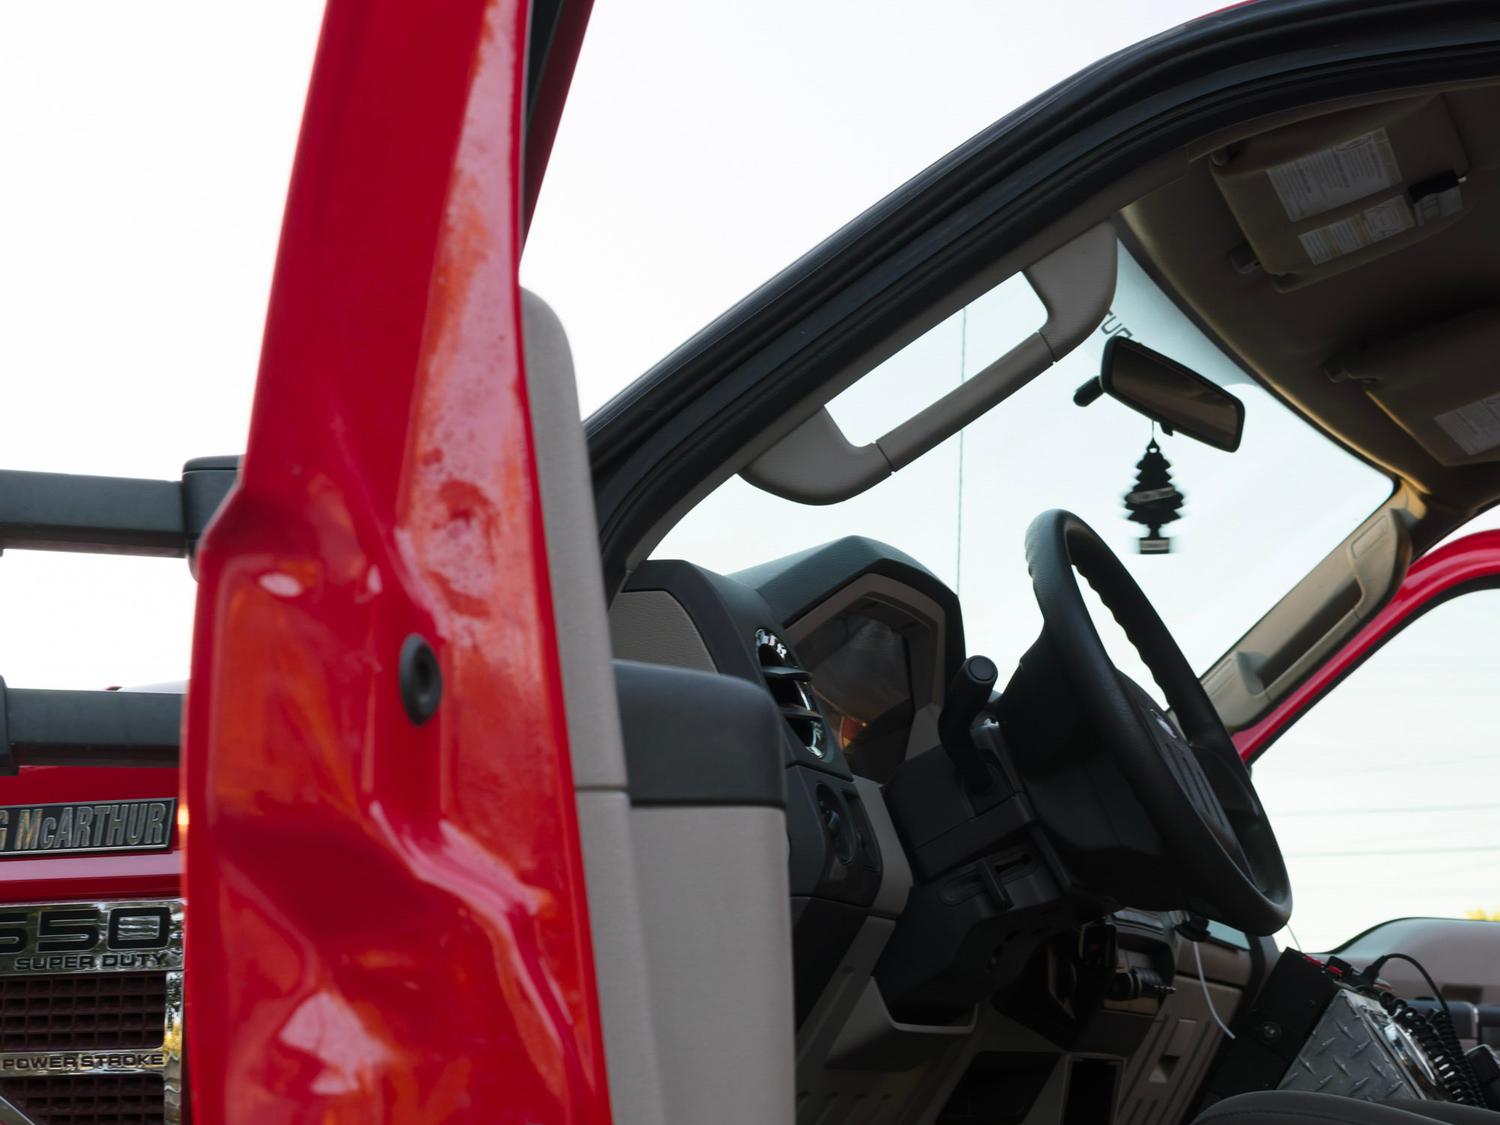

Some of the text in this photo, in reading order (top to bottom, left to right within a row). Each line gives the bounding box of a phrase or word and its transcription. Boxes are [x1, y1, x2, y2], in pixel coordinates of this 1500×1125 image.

[15, 803, 166, 849] McARTHUR
[15, 953, 163, 971] SUPER DUTY
